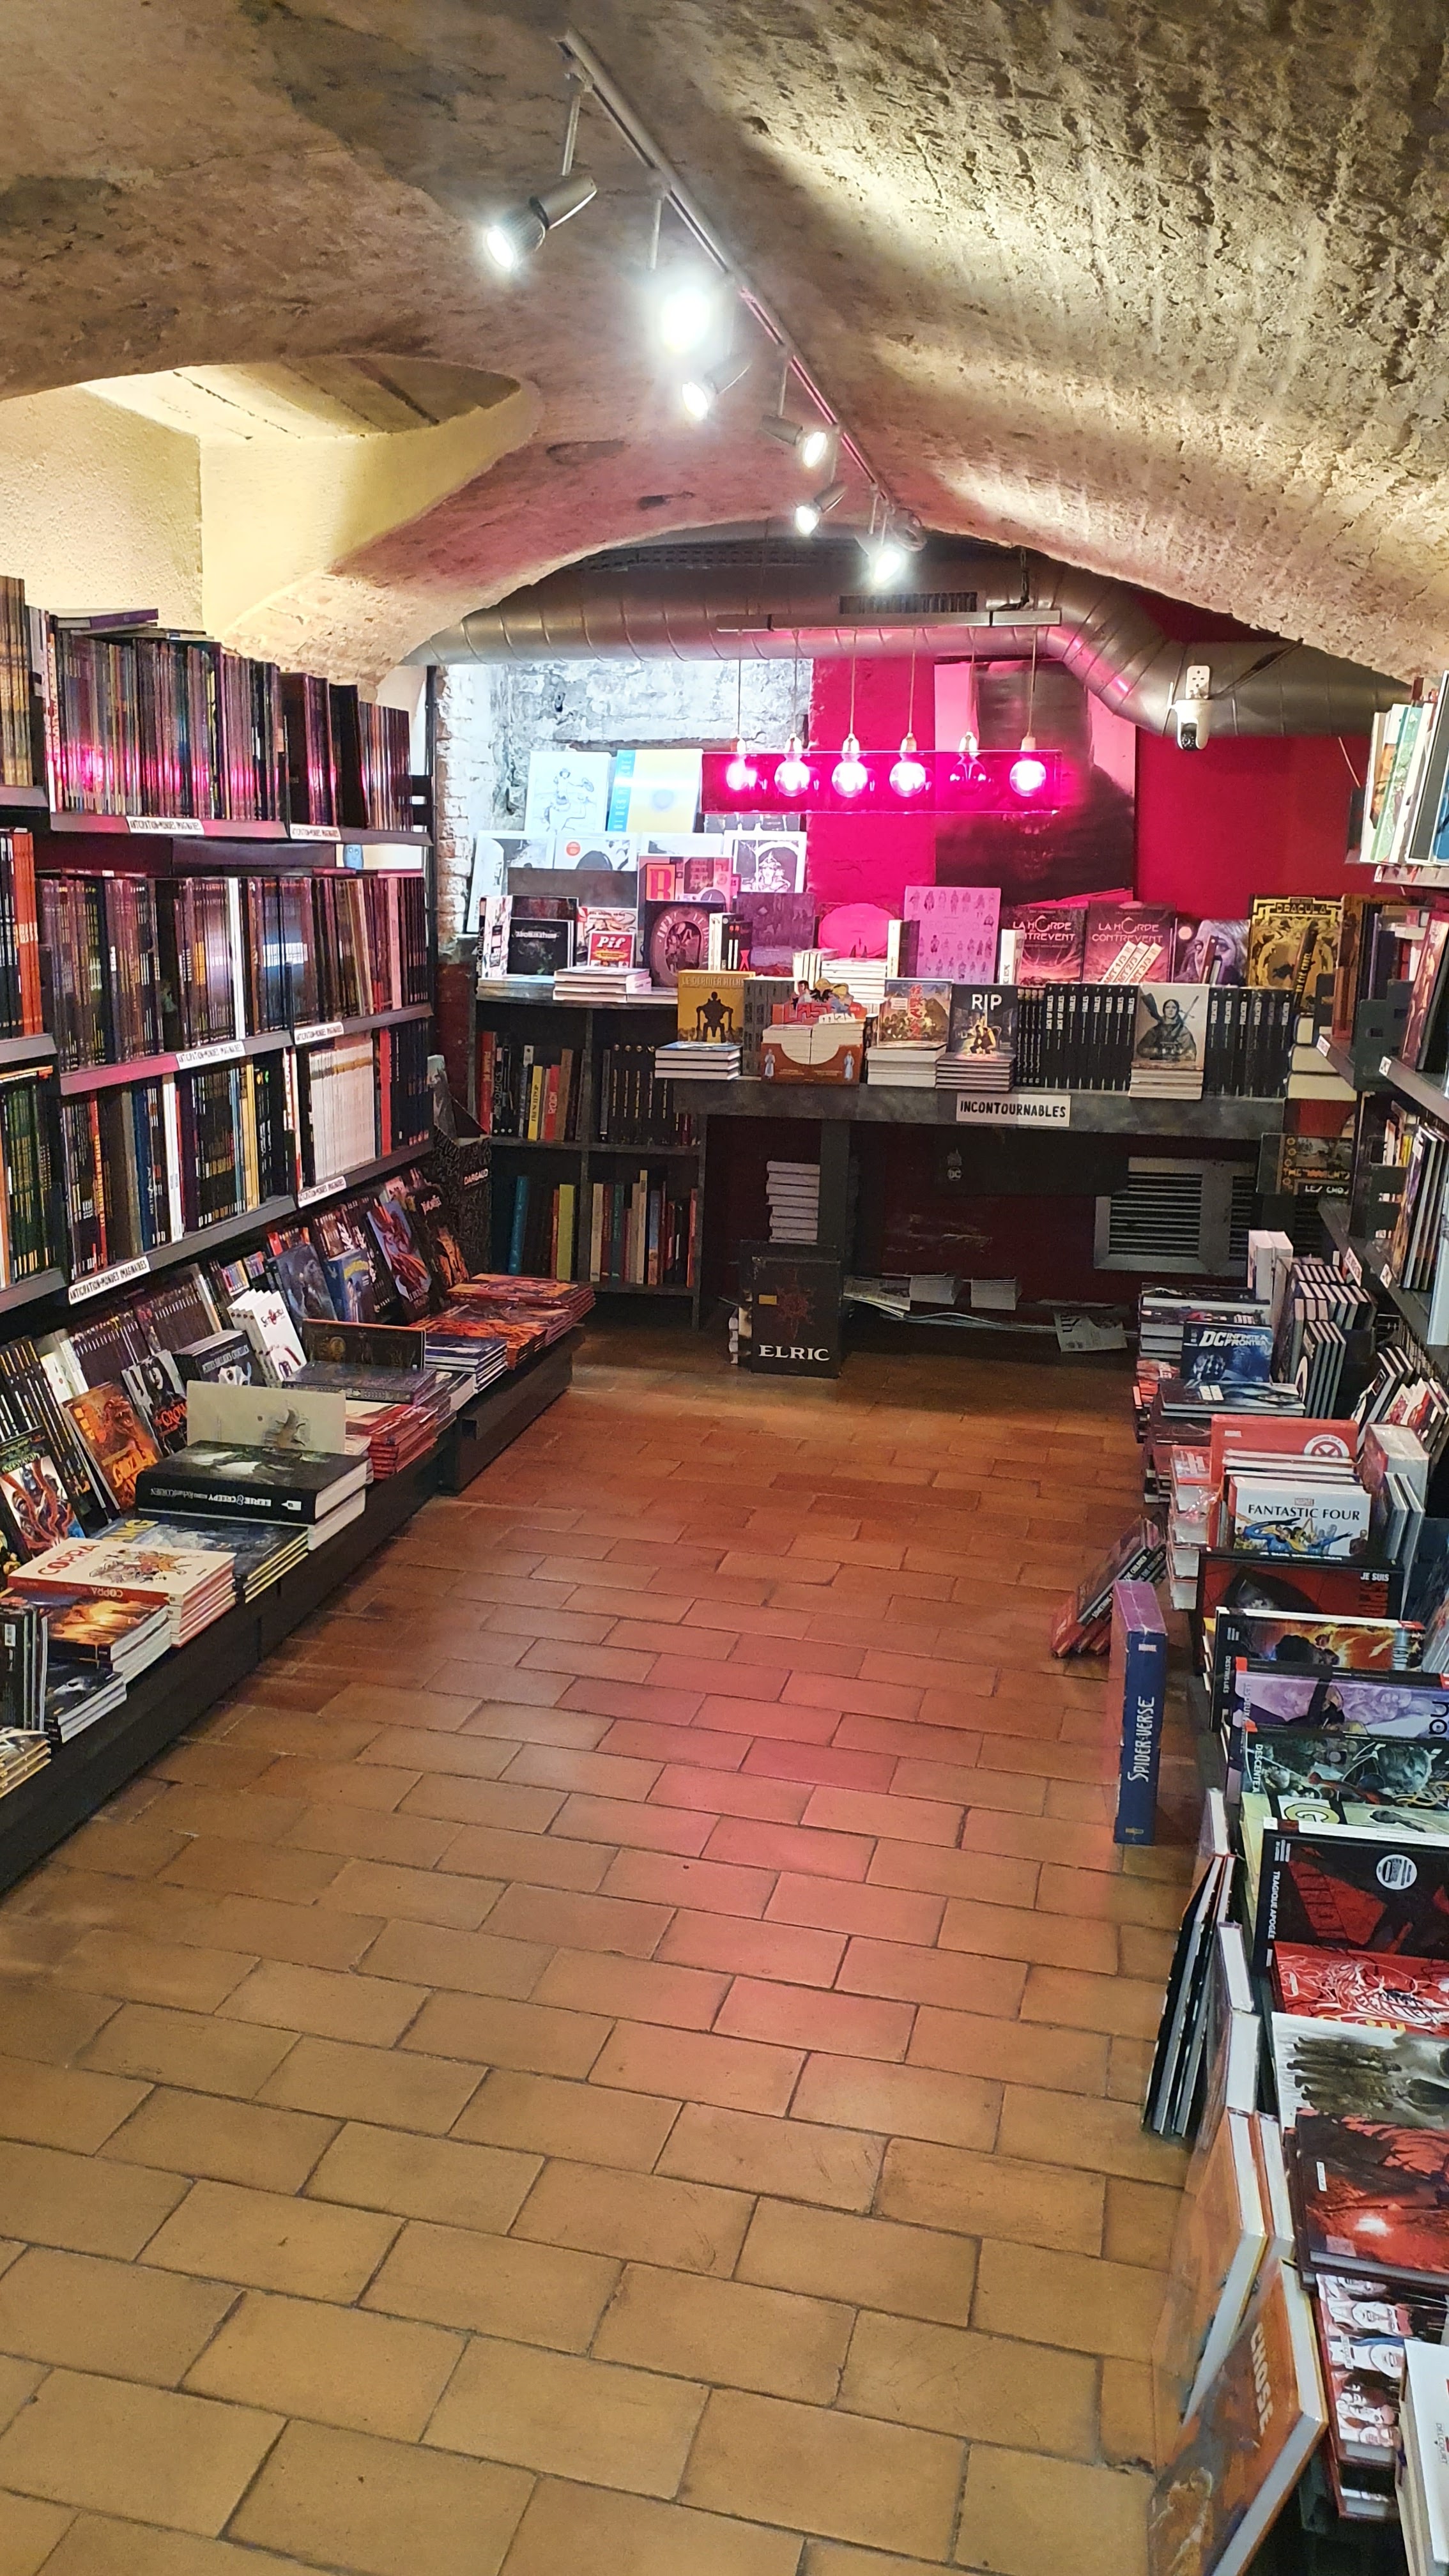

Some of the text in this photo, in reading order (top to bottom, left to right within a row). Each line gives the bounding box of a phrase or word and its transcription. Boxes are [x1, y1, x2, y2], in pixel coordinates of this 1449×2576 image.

[1276, 903, 1327, 914] DRACULA
[597, 935, 626, 949] Pif
[1091, 933, 1164, 944] CONTREVENT
[724, 977, 744, 986] ATLA
[971, 993, 1002, 1011] RIP
[960, 1101, 1066, 1118] INCONTOURNABLES
[947, 1169, 962, 1179] DC
[69, 1259, 148, 1300] ANTICIPATION-MONDES IMAGINAIRES
[1199, 1330, 1227, 1347] DC
[758, 1344, 830, 1362] ELRIC
[208, 1493, 236, 1504] CREEPY
[244, 1496, 272, 1506] EERIE
[1248, 1504, 1361, 1521] FANTASTIC FOUR
[38, 1544, 100, 1575] COPRA
[1130, 1554, 1147, 1575] CHILDREN
[1360, 1572, 1390, 1582] JE SUIS
[91, 1586, 124, 1598] COPRA
[1243, 1695, 1252, 1717] DEUX
[1253, 1743, 1264, 1786] DESCENTE
[1268, 1870, 1281, 1940] TRAGIQUE APOGÉE
[1341, 2336, 1354, 2370] DELCOURT
[1250, 2322, 1274, 2437] CHOSE
[1435, 2421, 1449, 2465] DELCOURT
